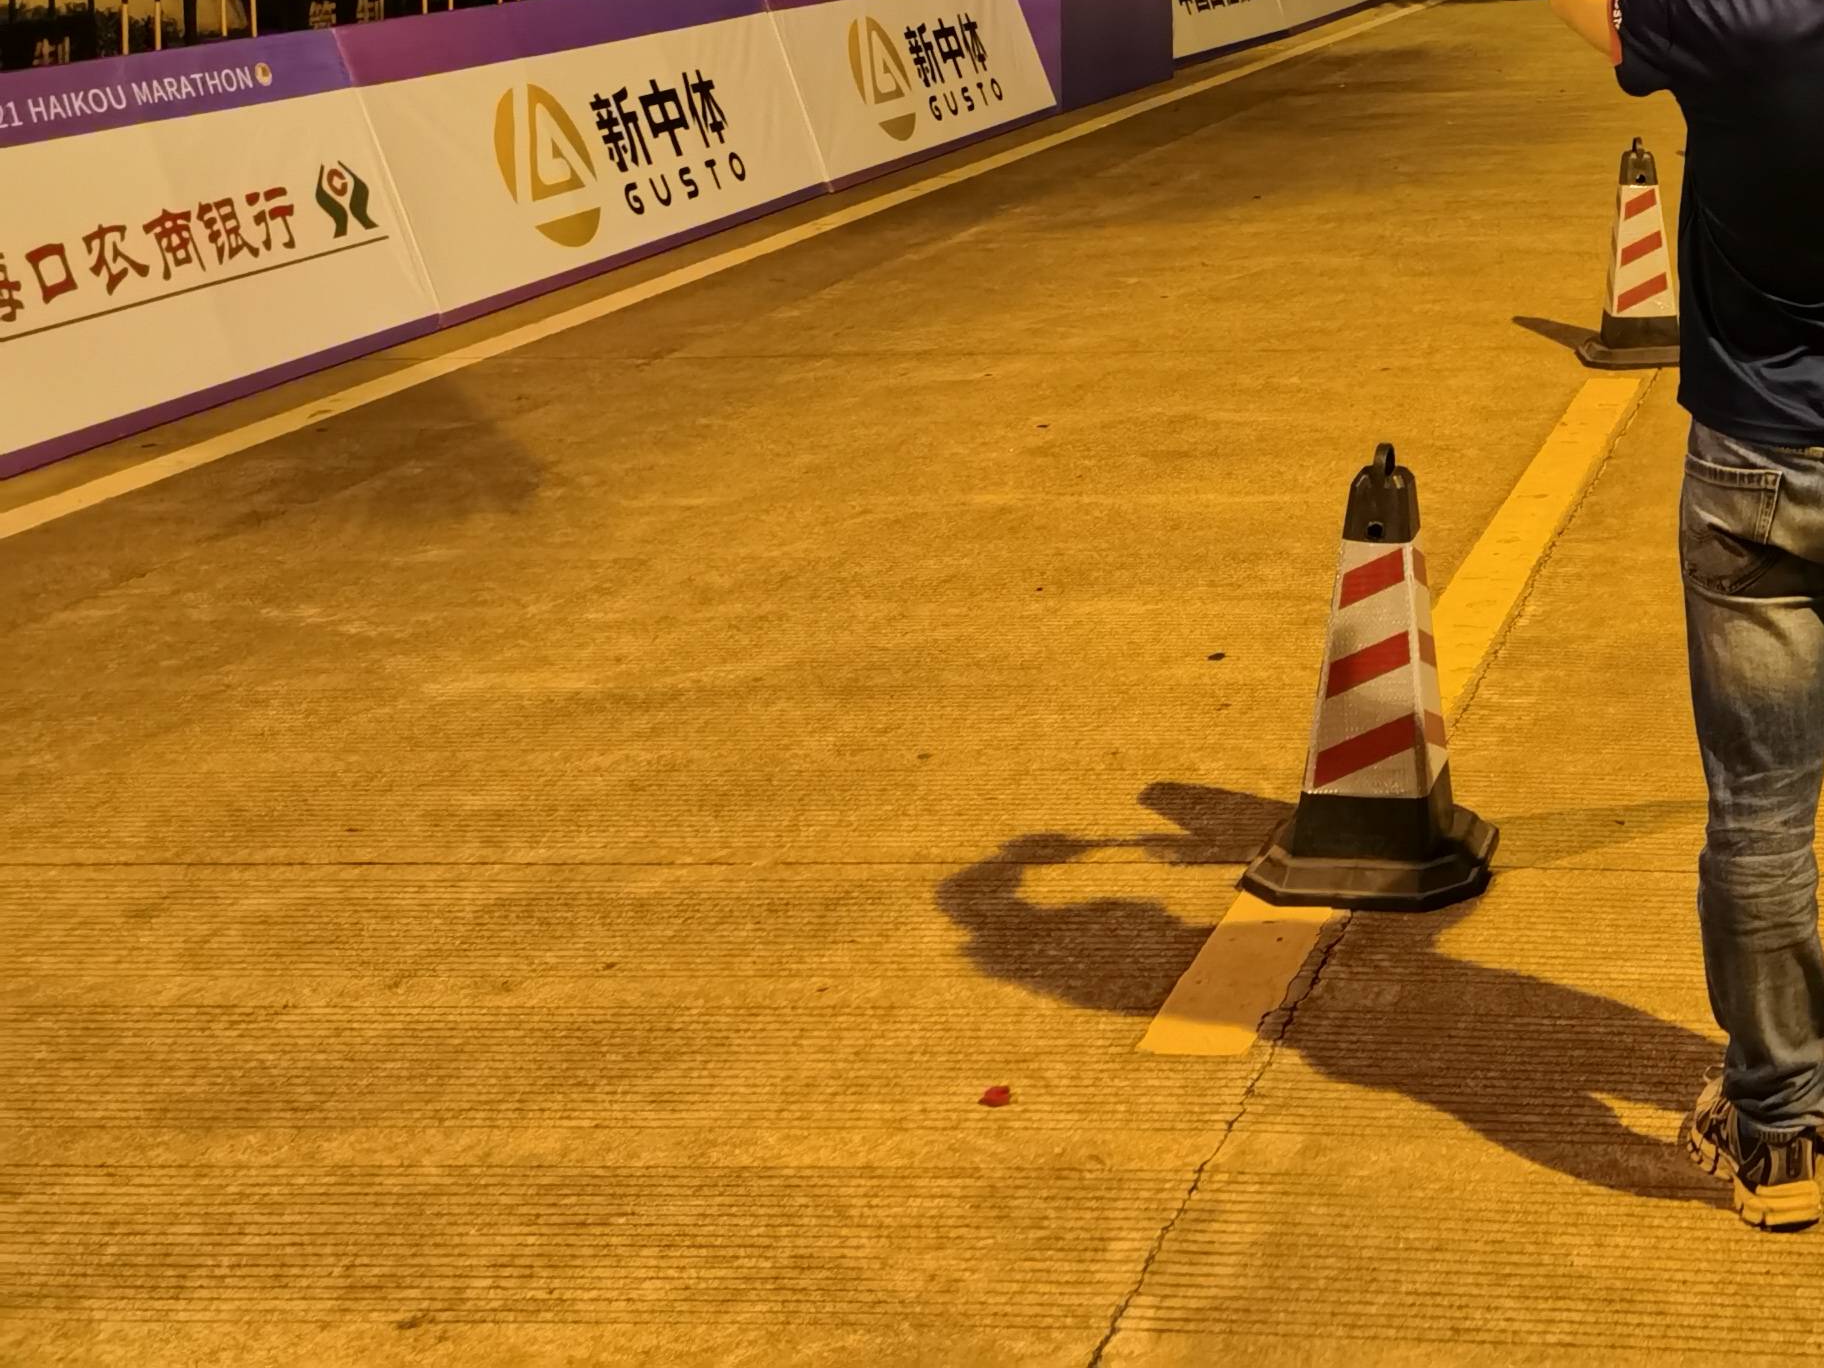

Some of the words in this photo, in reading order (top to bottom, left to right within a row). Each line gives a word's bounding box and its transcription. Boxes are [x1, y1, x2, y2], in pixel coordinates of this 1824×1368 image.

[903, 13, 988, 88] 新中体
[29, 85, 127, 124] HAIKOU
[135, 66, 254, 106] MARATHON
[588, 69, 728, 173] 新中体
[929, 78, 1003, 122] GUSTO
[624, 152, 747, 216] GUSTO
